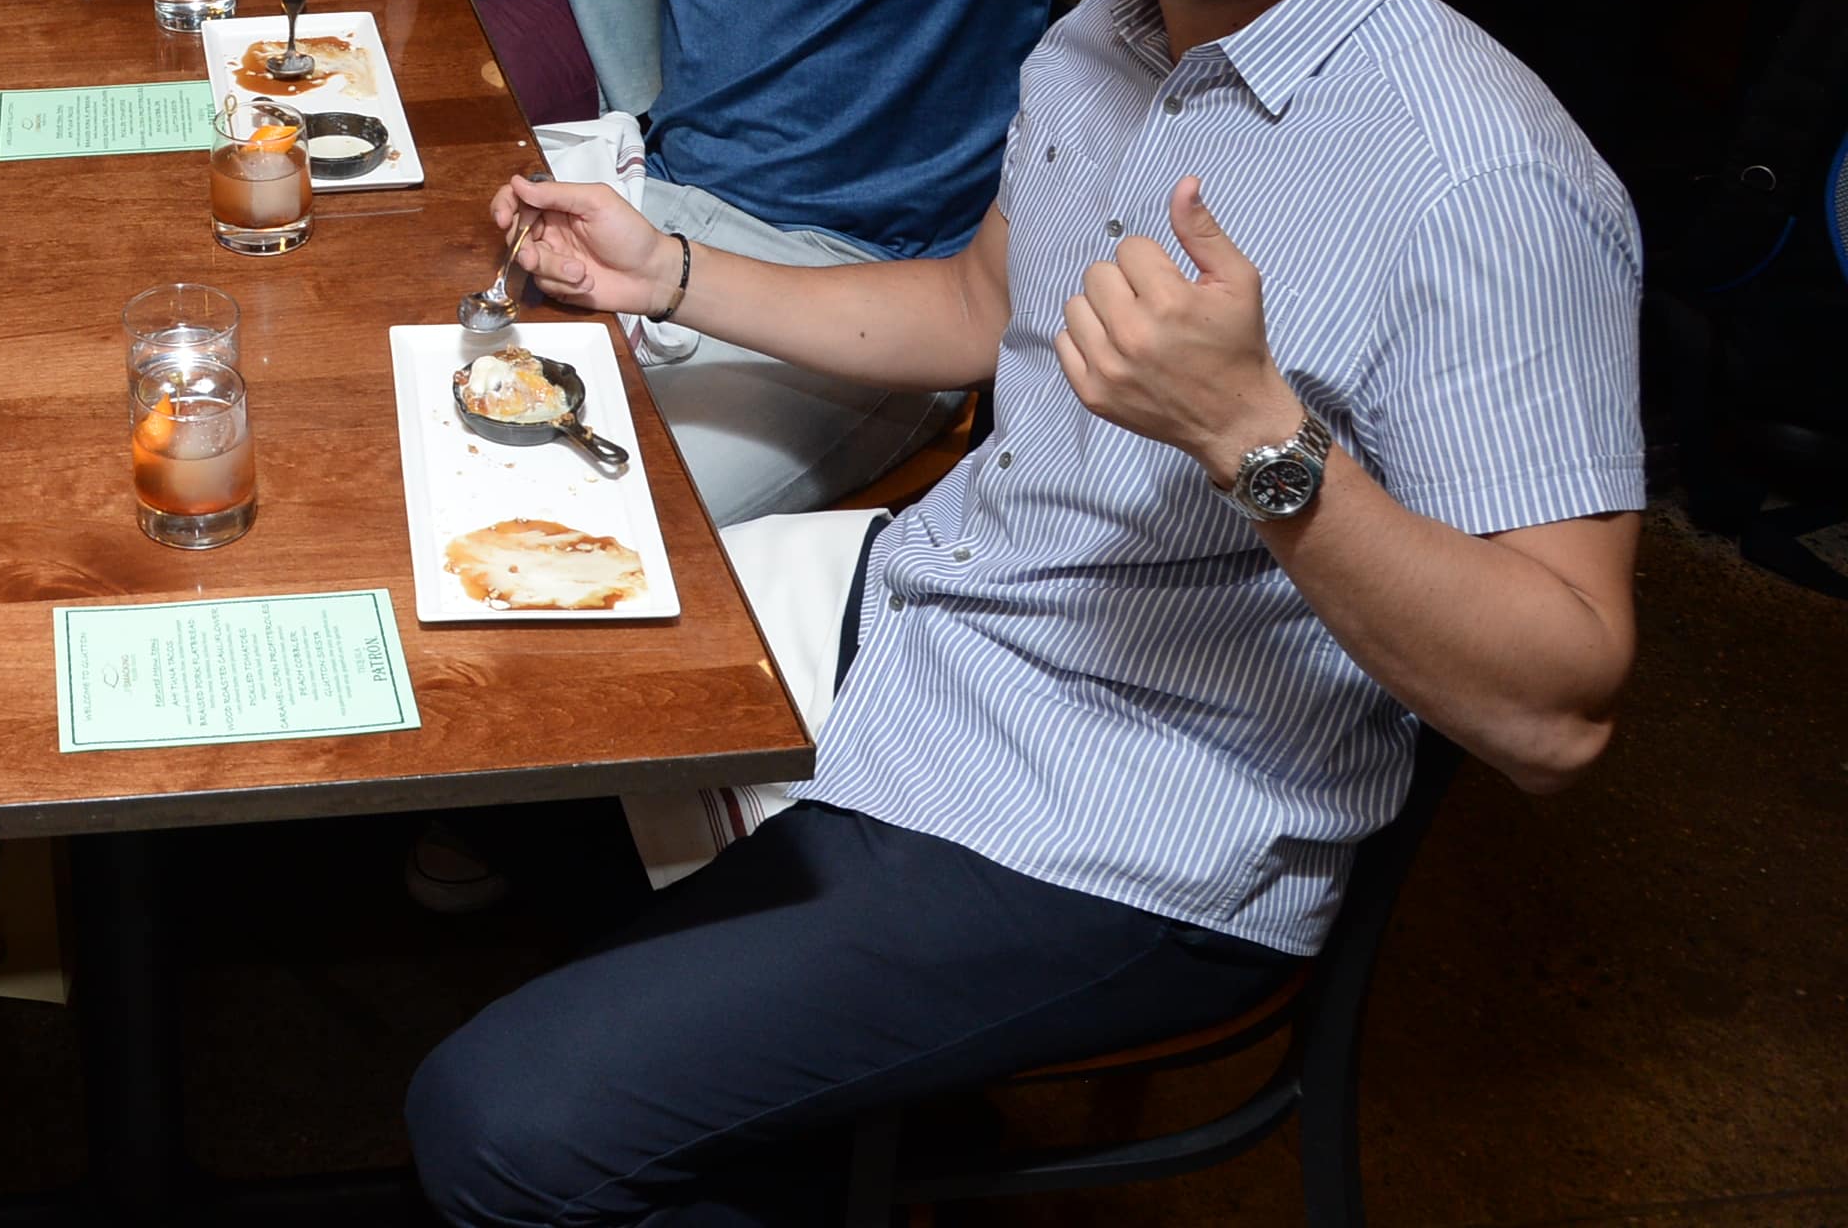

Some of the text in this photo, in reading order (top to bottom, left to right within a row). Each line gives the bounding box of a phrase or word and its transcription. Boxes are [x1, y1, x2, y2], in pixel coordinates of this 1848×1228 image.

[165, 640, 175, 664] TACOS
[288, 629, 307, 696] PEACH COBBLER
[312, 631, 324, 658] SIESTA
[360, 636, 387, 682] PATRÓN
[81, 670, 89, 680] TO
[218, 665, 231, 703] ROASTED
[238, 627, 257, 706] PICKLED TOMATOES
[270, 664, 281, 686] CORN
[274, 688, 289, 728] CARAMEL
